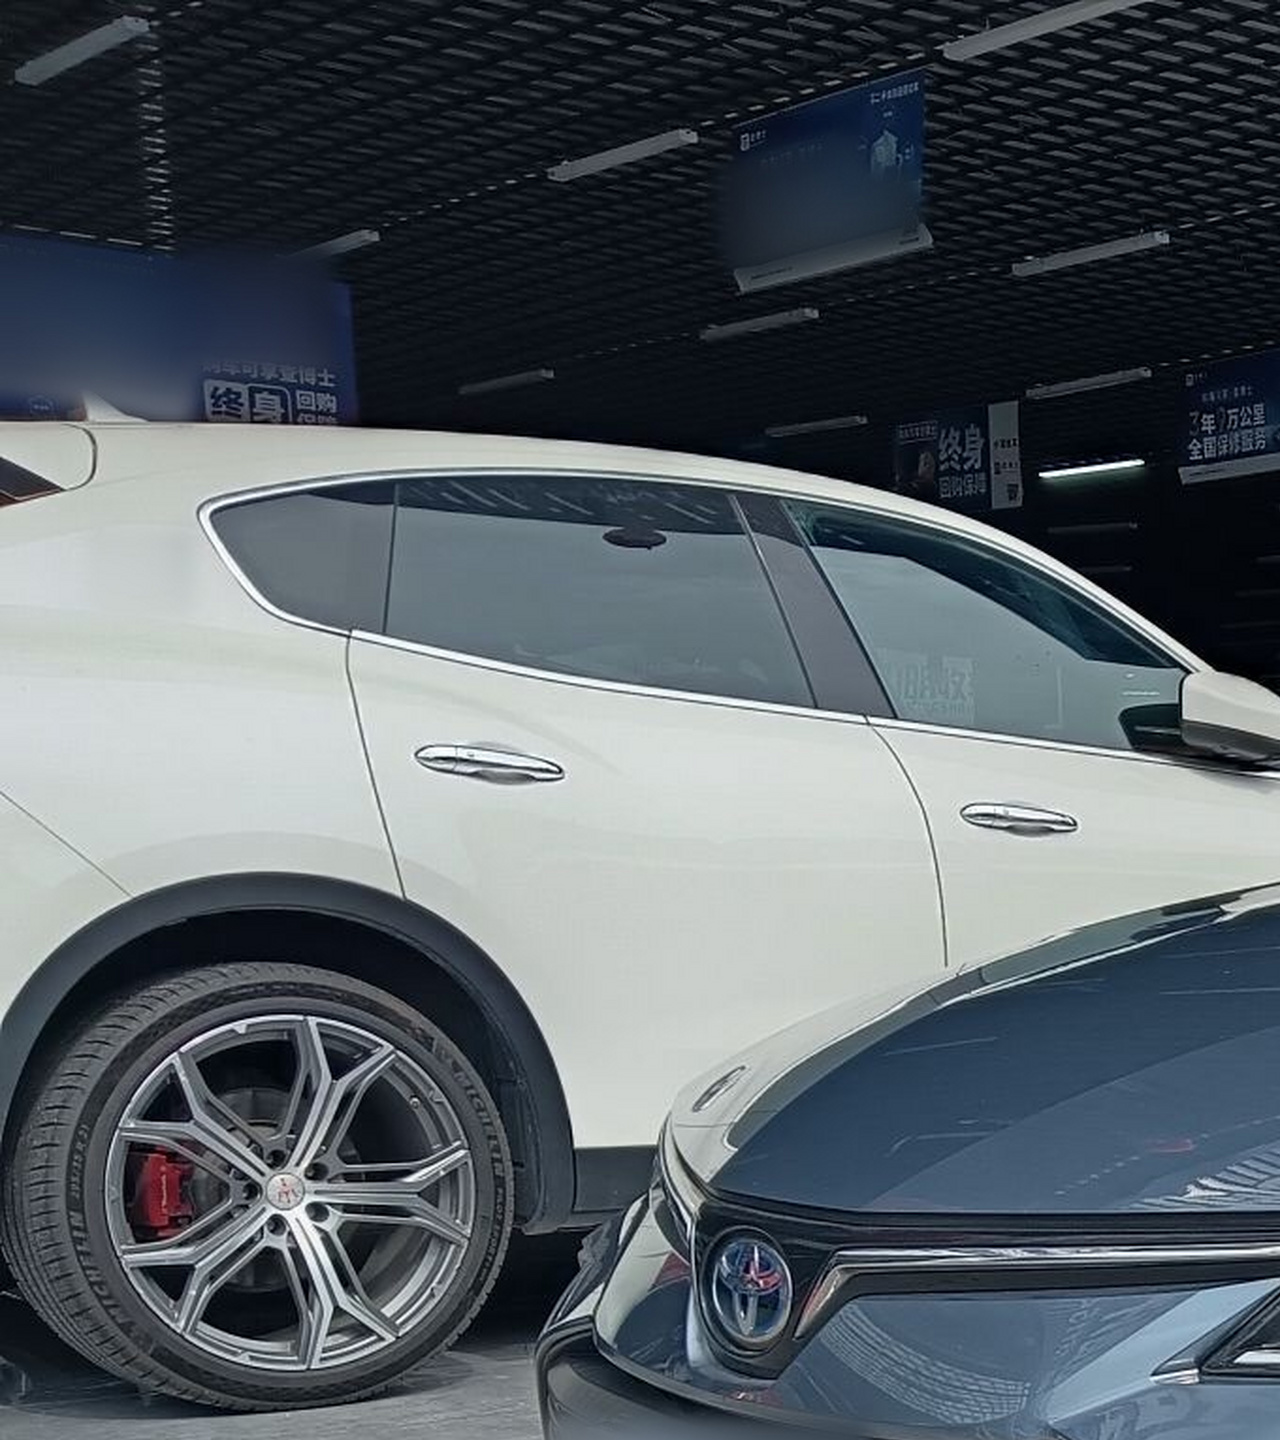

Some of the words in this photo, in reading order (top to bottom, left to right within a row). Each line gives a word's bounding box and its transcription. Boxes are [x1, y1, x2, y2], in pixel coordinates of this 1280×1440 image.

[938, 422, 985, 471] 终身
[1187, 428, 1266, 462] 全国保修服务
